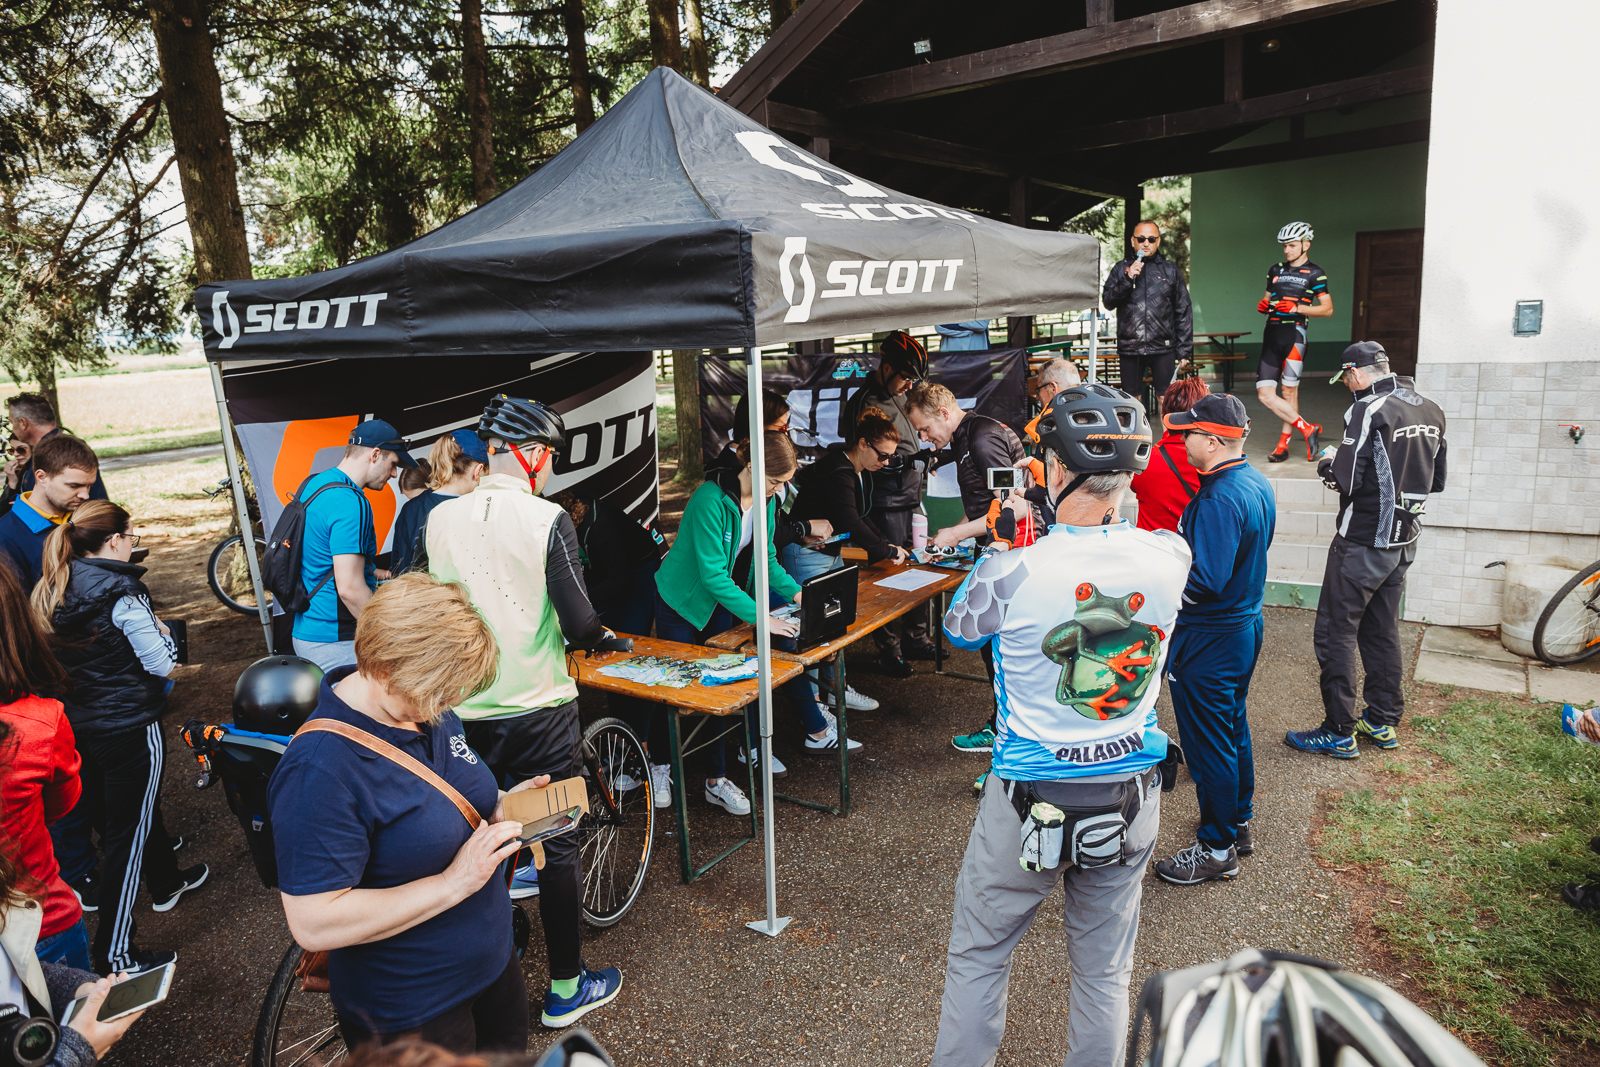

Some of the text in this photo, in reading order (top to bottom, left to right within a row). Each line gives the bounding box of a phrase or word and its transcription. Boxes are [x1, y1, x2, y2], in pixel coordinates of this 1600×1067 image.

[820, 259, 964, 298] SCOTT
[244, 293, 388, 333] SCOTT
[551, 402, 654, 476] OTT
[1392, 424, 1441, 442] FORCE
[1055, 732, 1144, 763] PALADIN
